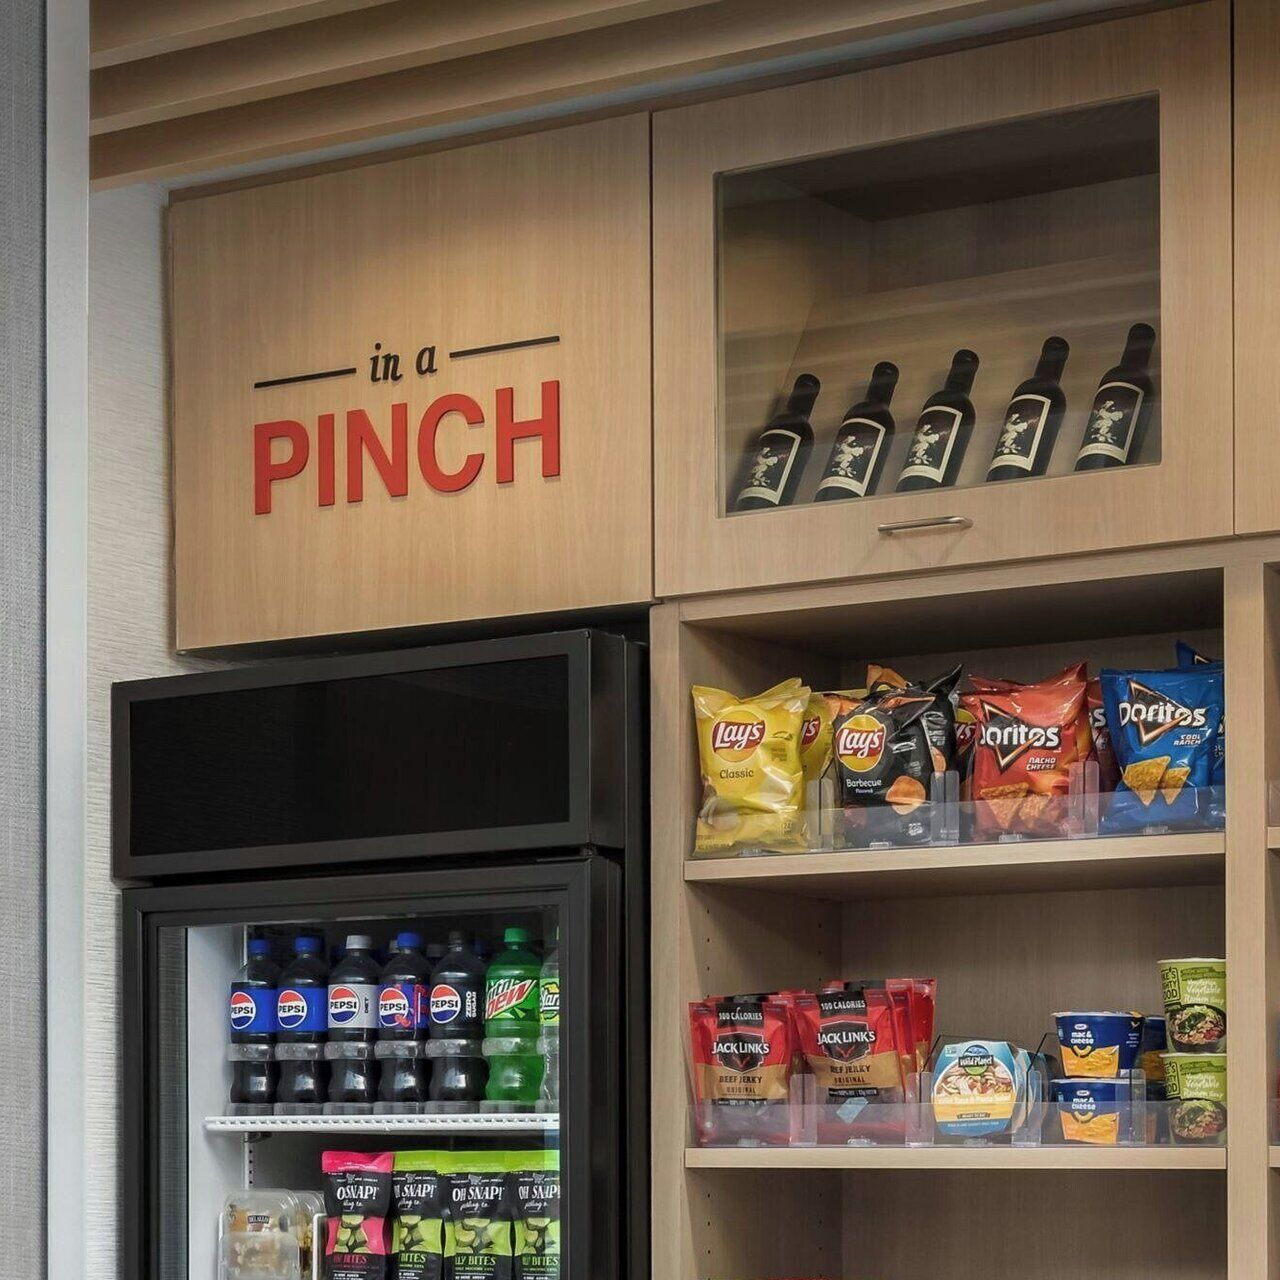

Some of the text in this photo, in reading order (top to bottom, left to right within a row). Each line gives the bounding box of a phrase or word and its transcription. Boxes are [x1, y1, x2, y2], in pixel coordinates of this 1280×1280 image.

[370, 342, 438, 383] in a
[254, 380, 561, 515] PINCH
[1119, 701, 1207, 728] Doritos
[714, 721, 764, 751] Lay's
[838, 728, 883, 759] Lay's
[719, 768, 755, 780] Classic
[845, 777, 882, 788] Barbecue
[278, 1004, 305, 1014] PEPSI
[330, 1000, 358, 1010] PEPSI
[379, 1002, 406, 1012] PEPSI
[431, 999, 459, 1009] PEPSI
[821, 1000, 866, 1010] 100 CALORIES
[231, 1005, 254, 1015] PEPSI
[719, 1011, 763, 1021] 100 CALORIES
[817, 1031, 842, 1045] JACK
[712, 1041, 739, 1054] JACK
[739, 1075, 763, 1085] JERKY
[401, 1184, 436, 1198] SNAP!
[452, 1186, 503, 1201] OH SNAP!
[468, 1255, 497, 1266] BITES
[531, 1256, 559, 1266] BITES
